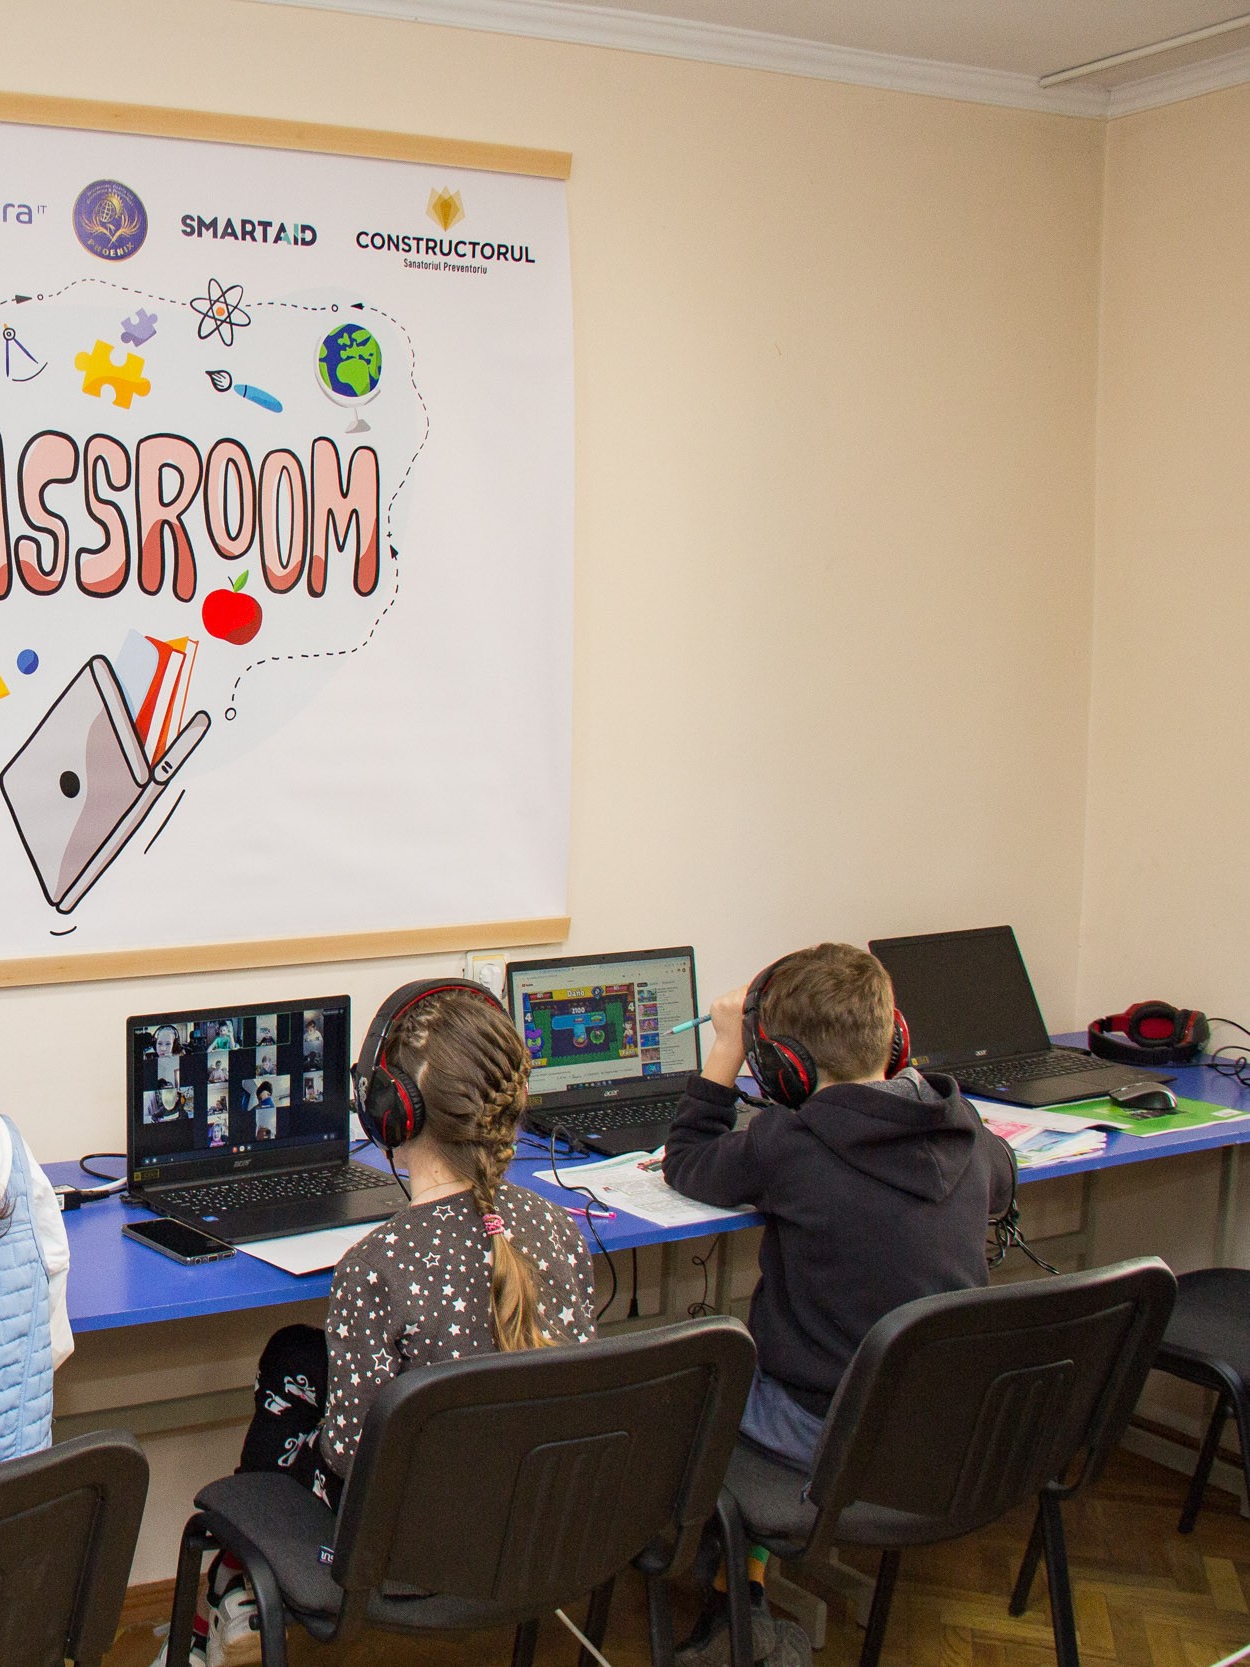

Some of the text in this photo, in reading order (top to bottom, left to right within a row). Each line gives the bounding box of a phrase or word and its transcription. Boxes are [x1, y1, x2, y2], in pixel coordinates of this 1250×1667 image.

[37, 205, 47, 215] IT
[180, 213, 318, 247] SMARTAID
[87, 239, 135, 257] PHOENIX
[355, 231, 536, 264] CONSTRUCTORUL
[403, 258, 488, 275] Sanatoriul Preventoriu
